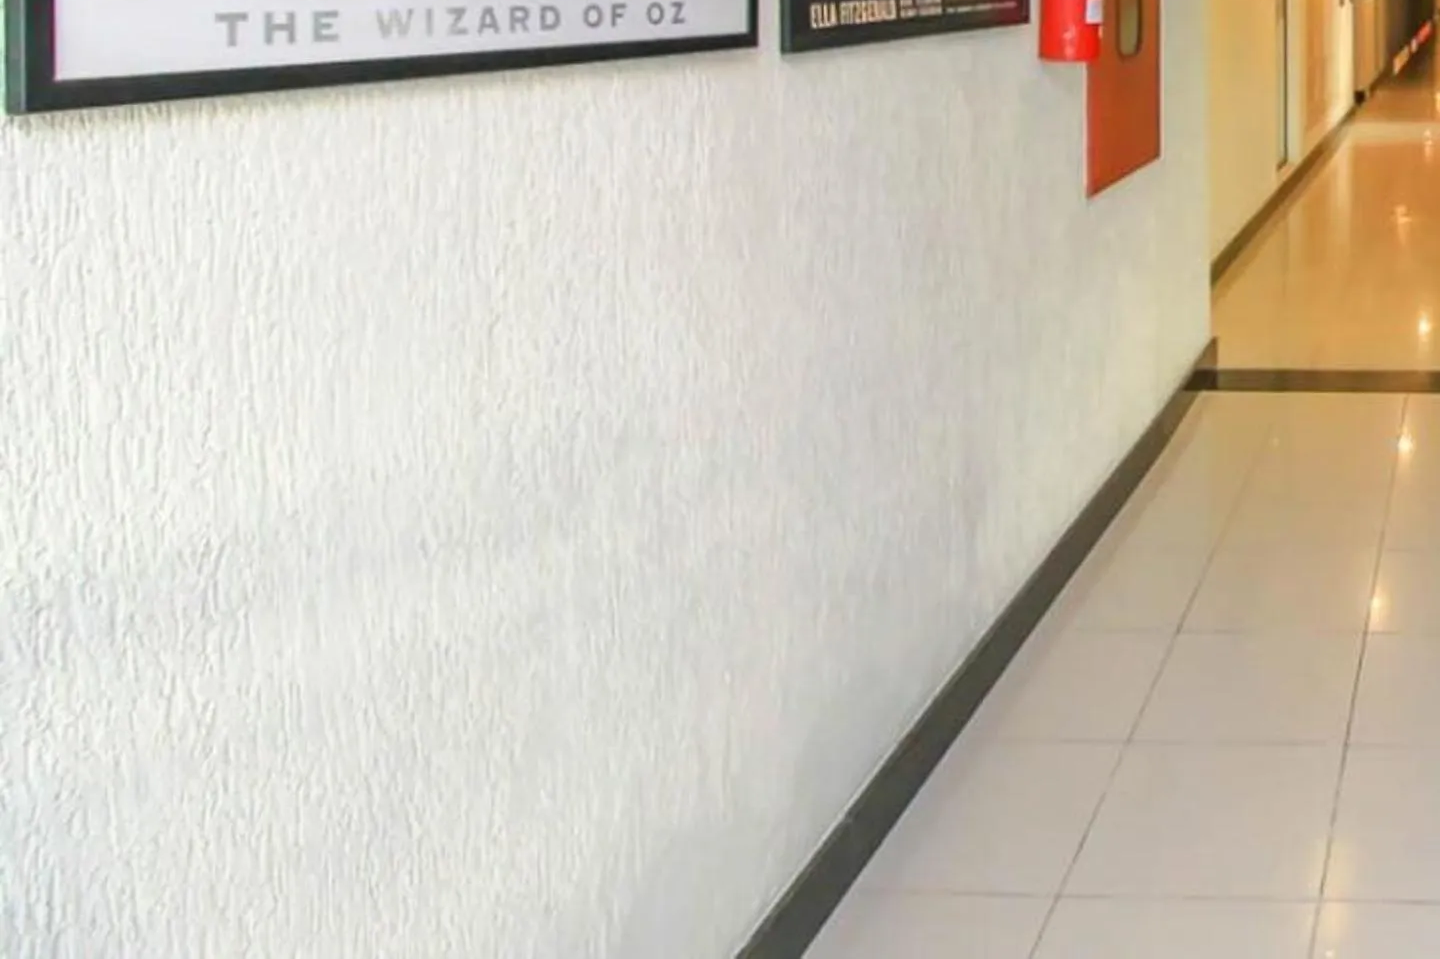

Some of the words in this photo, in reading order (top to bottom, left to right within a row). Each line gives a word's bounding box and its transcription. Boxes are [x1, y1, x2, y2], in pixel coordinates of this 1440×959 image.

[214, 10, 341, 47] THE
[374, 2, 562, 39] WIZARD
[582, 2, 628, 29] OF
[645, 0, 687, 26] OZ
[809, 2, 838, 29] ELLA
